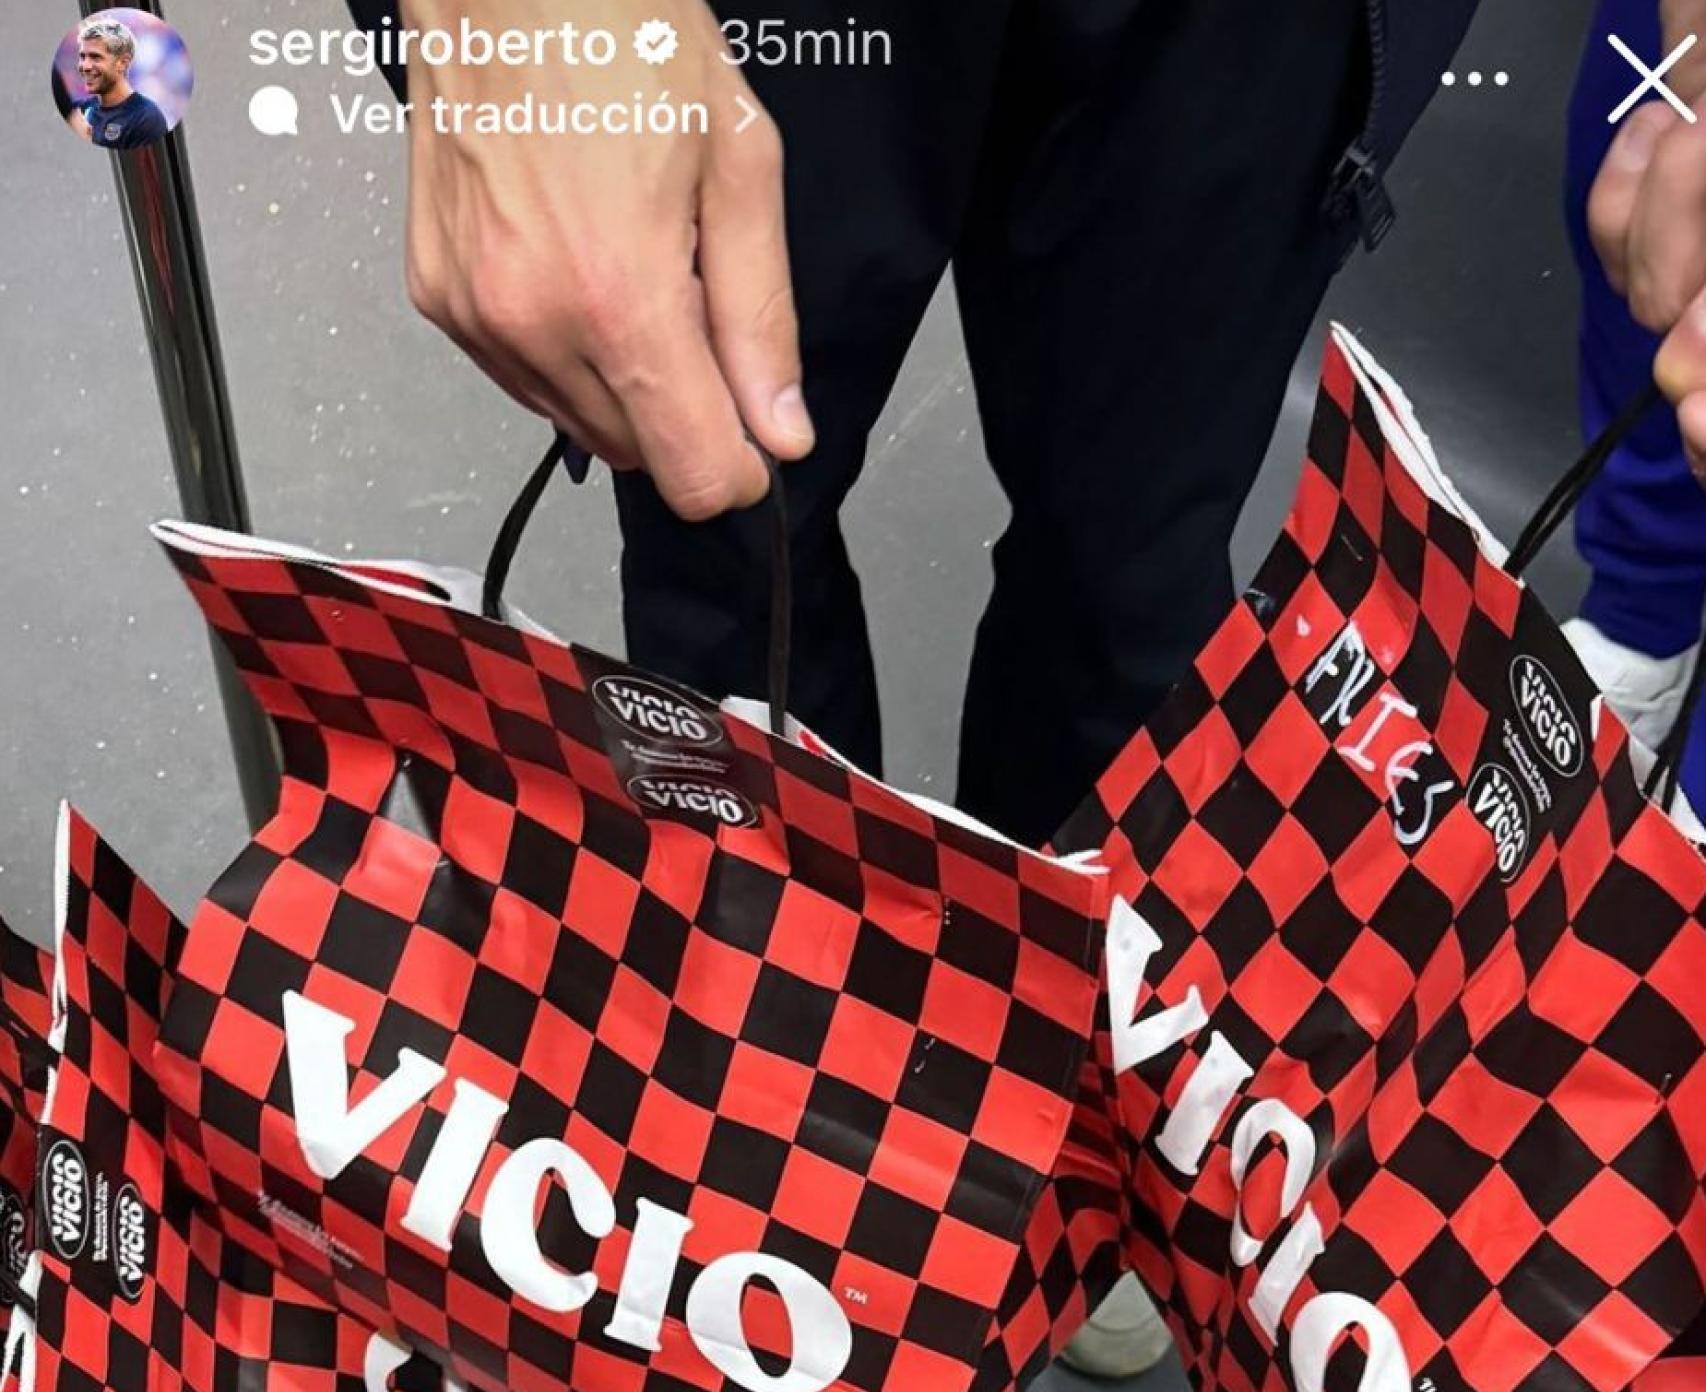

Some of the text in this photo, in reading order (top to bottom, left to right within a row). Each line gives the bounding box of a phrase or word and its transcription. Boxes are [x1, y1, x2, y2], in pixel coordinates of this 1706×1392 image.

[608, 694, 708, 741] VICIO
[1521, 672, 1572, 767] VICIO
[642, 787, 744, 823] VICIO
[1475, 782, 1517, 873] VICIO
